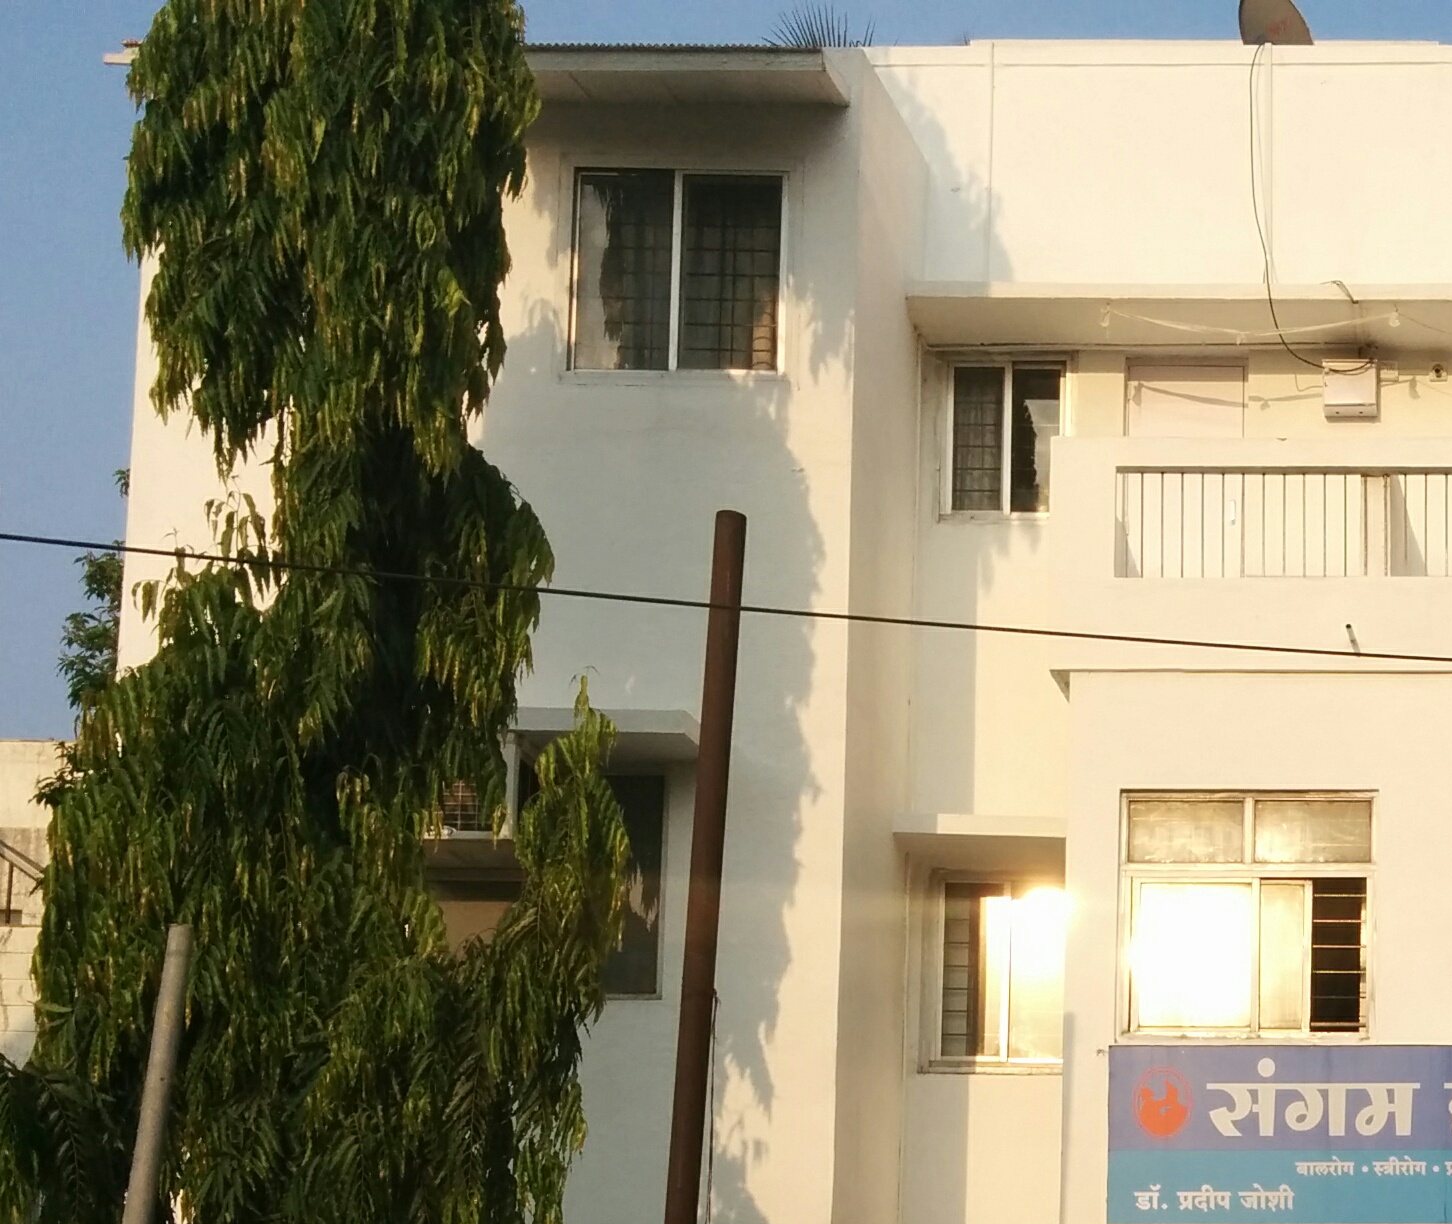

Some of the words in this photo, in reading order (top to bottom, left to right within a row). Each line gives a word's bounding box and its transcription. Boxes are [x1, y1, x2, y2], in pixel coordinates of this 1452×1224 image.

[1206, 1057, 1421, 1137] संगम
[1295, 1155, 1354, 1176] बालरोग
[1372, 1155, 1426, 1176] स्त्रीरोग
[1133, 1184, 1168, 1211] डॉ.
[1176, 1184, 1231, 1212] प्रदीप
[1237, 1183, 1295, 1212] जोशी
